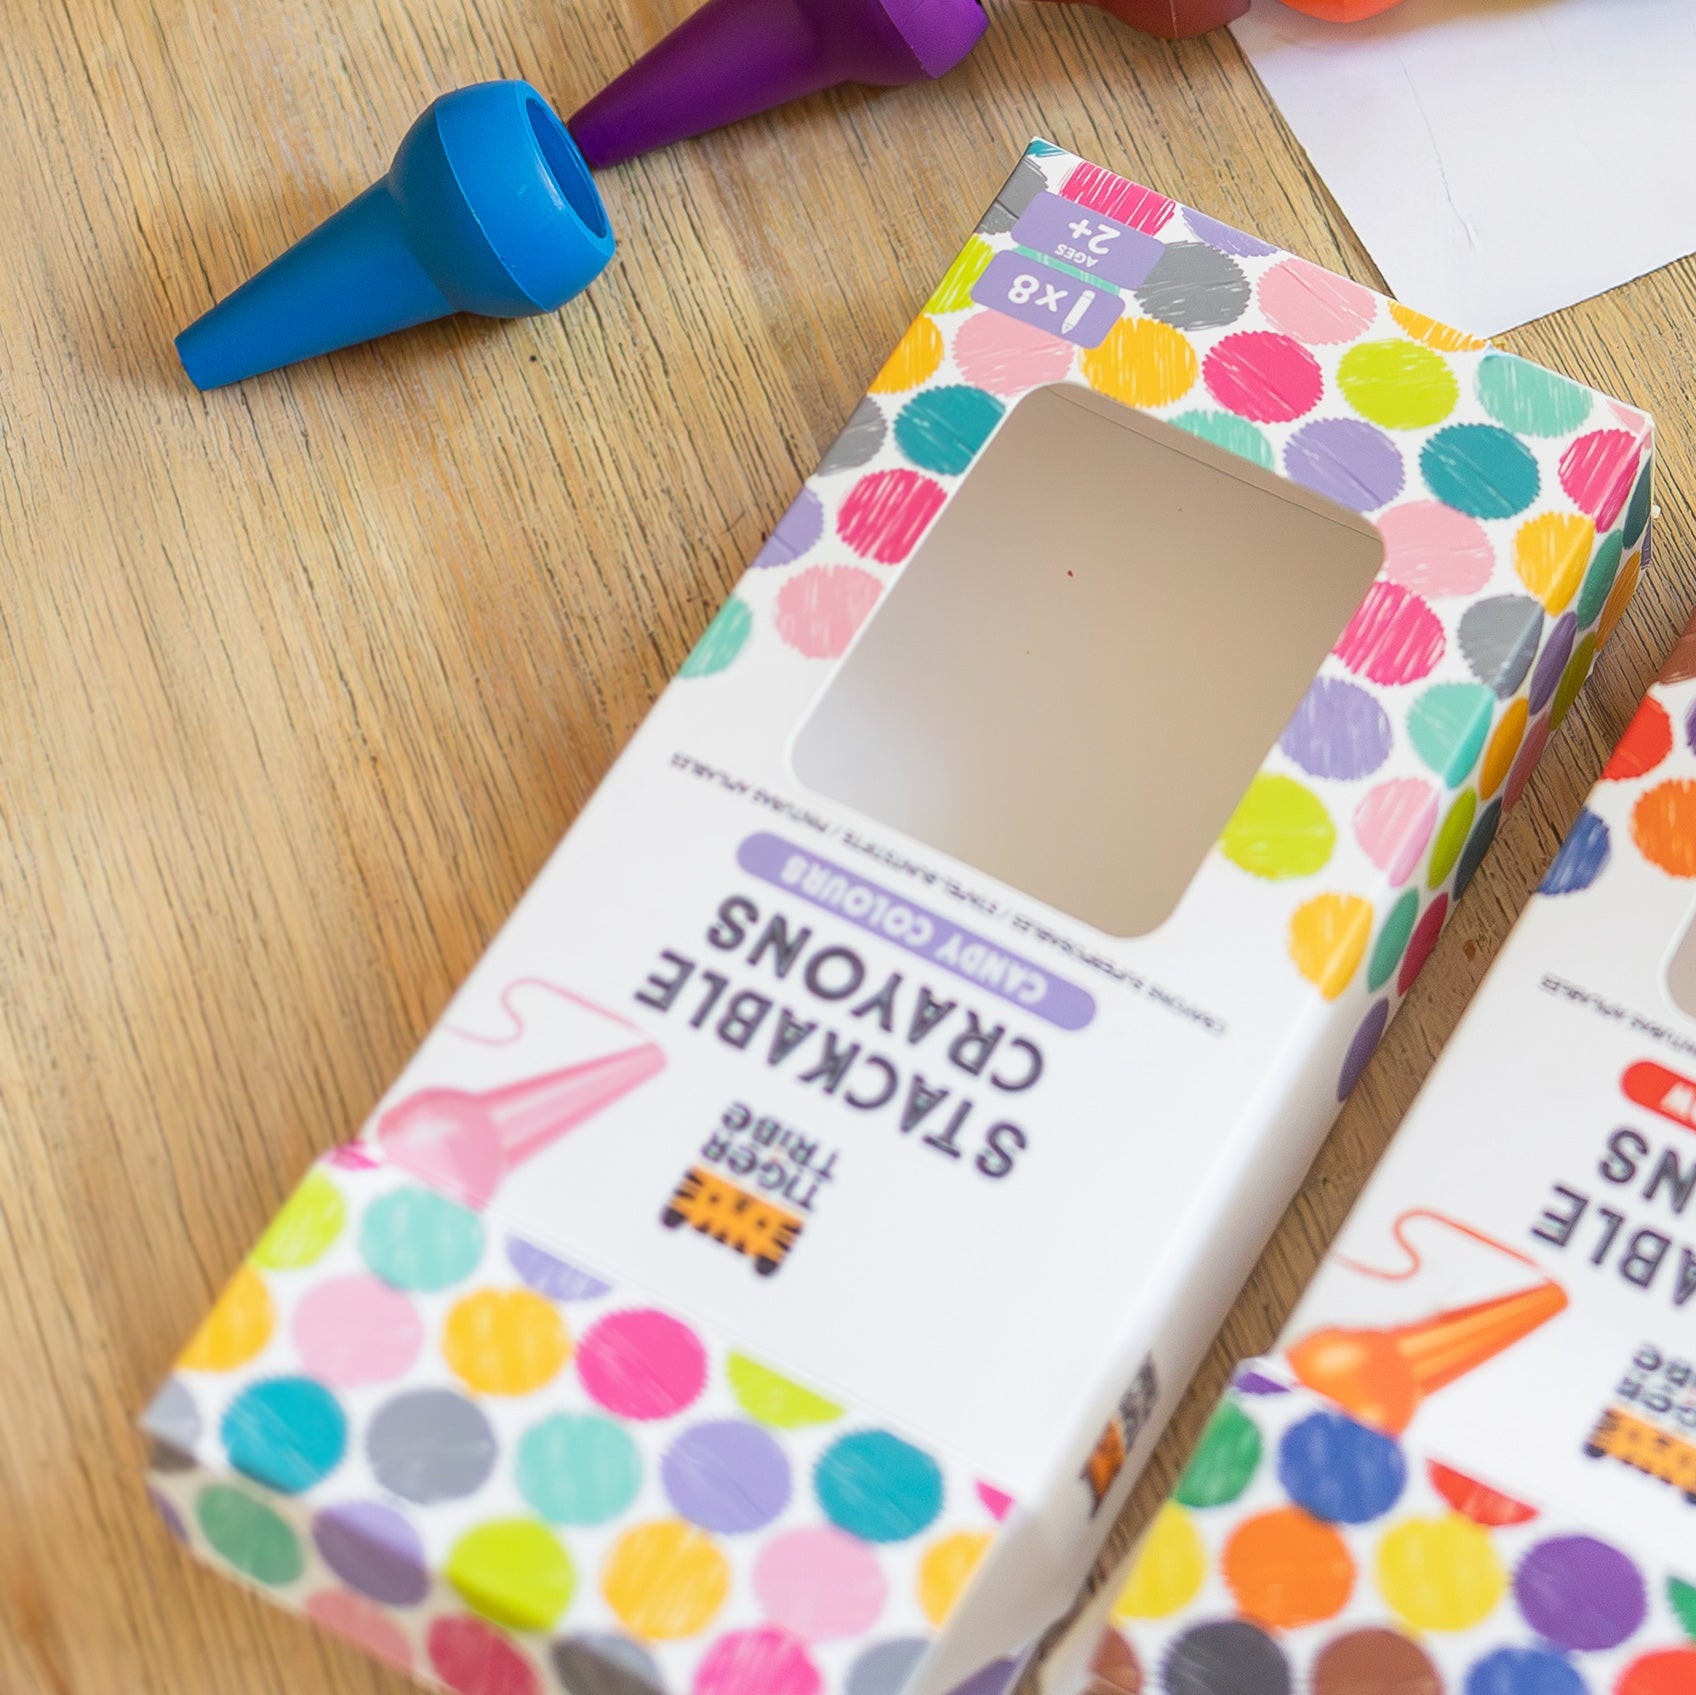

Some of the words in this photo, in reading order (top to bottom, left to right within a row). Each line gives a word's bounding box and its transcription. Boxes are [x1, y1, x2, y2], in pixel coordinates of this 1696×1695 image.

[1055, 244, 1098, 267] AGES
[1068, 219, 1121, 254] 2+
[780, 854, 934, 946] COLOURS
[707, 895, 1042, 1091] CRAYONS
[933, 932, 1048, 1005] CANDY
[634, 949, 1026, 1178] STACKABLE
